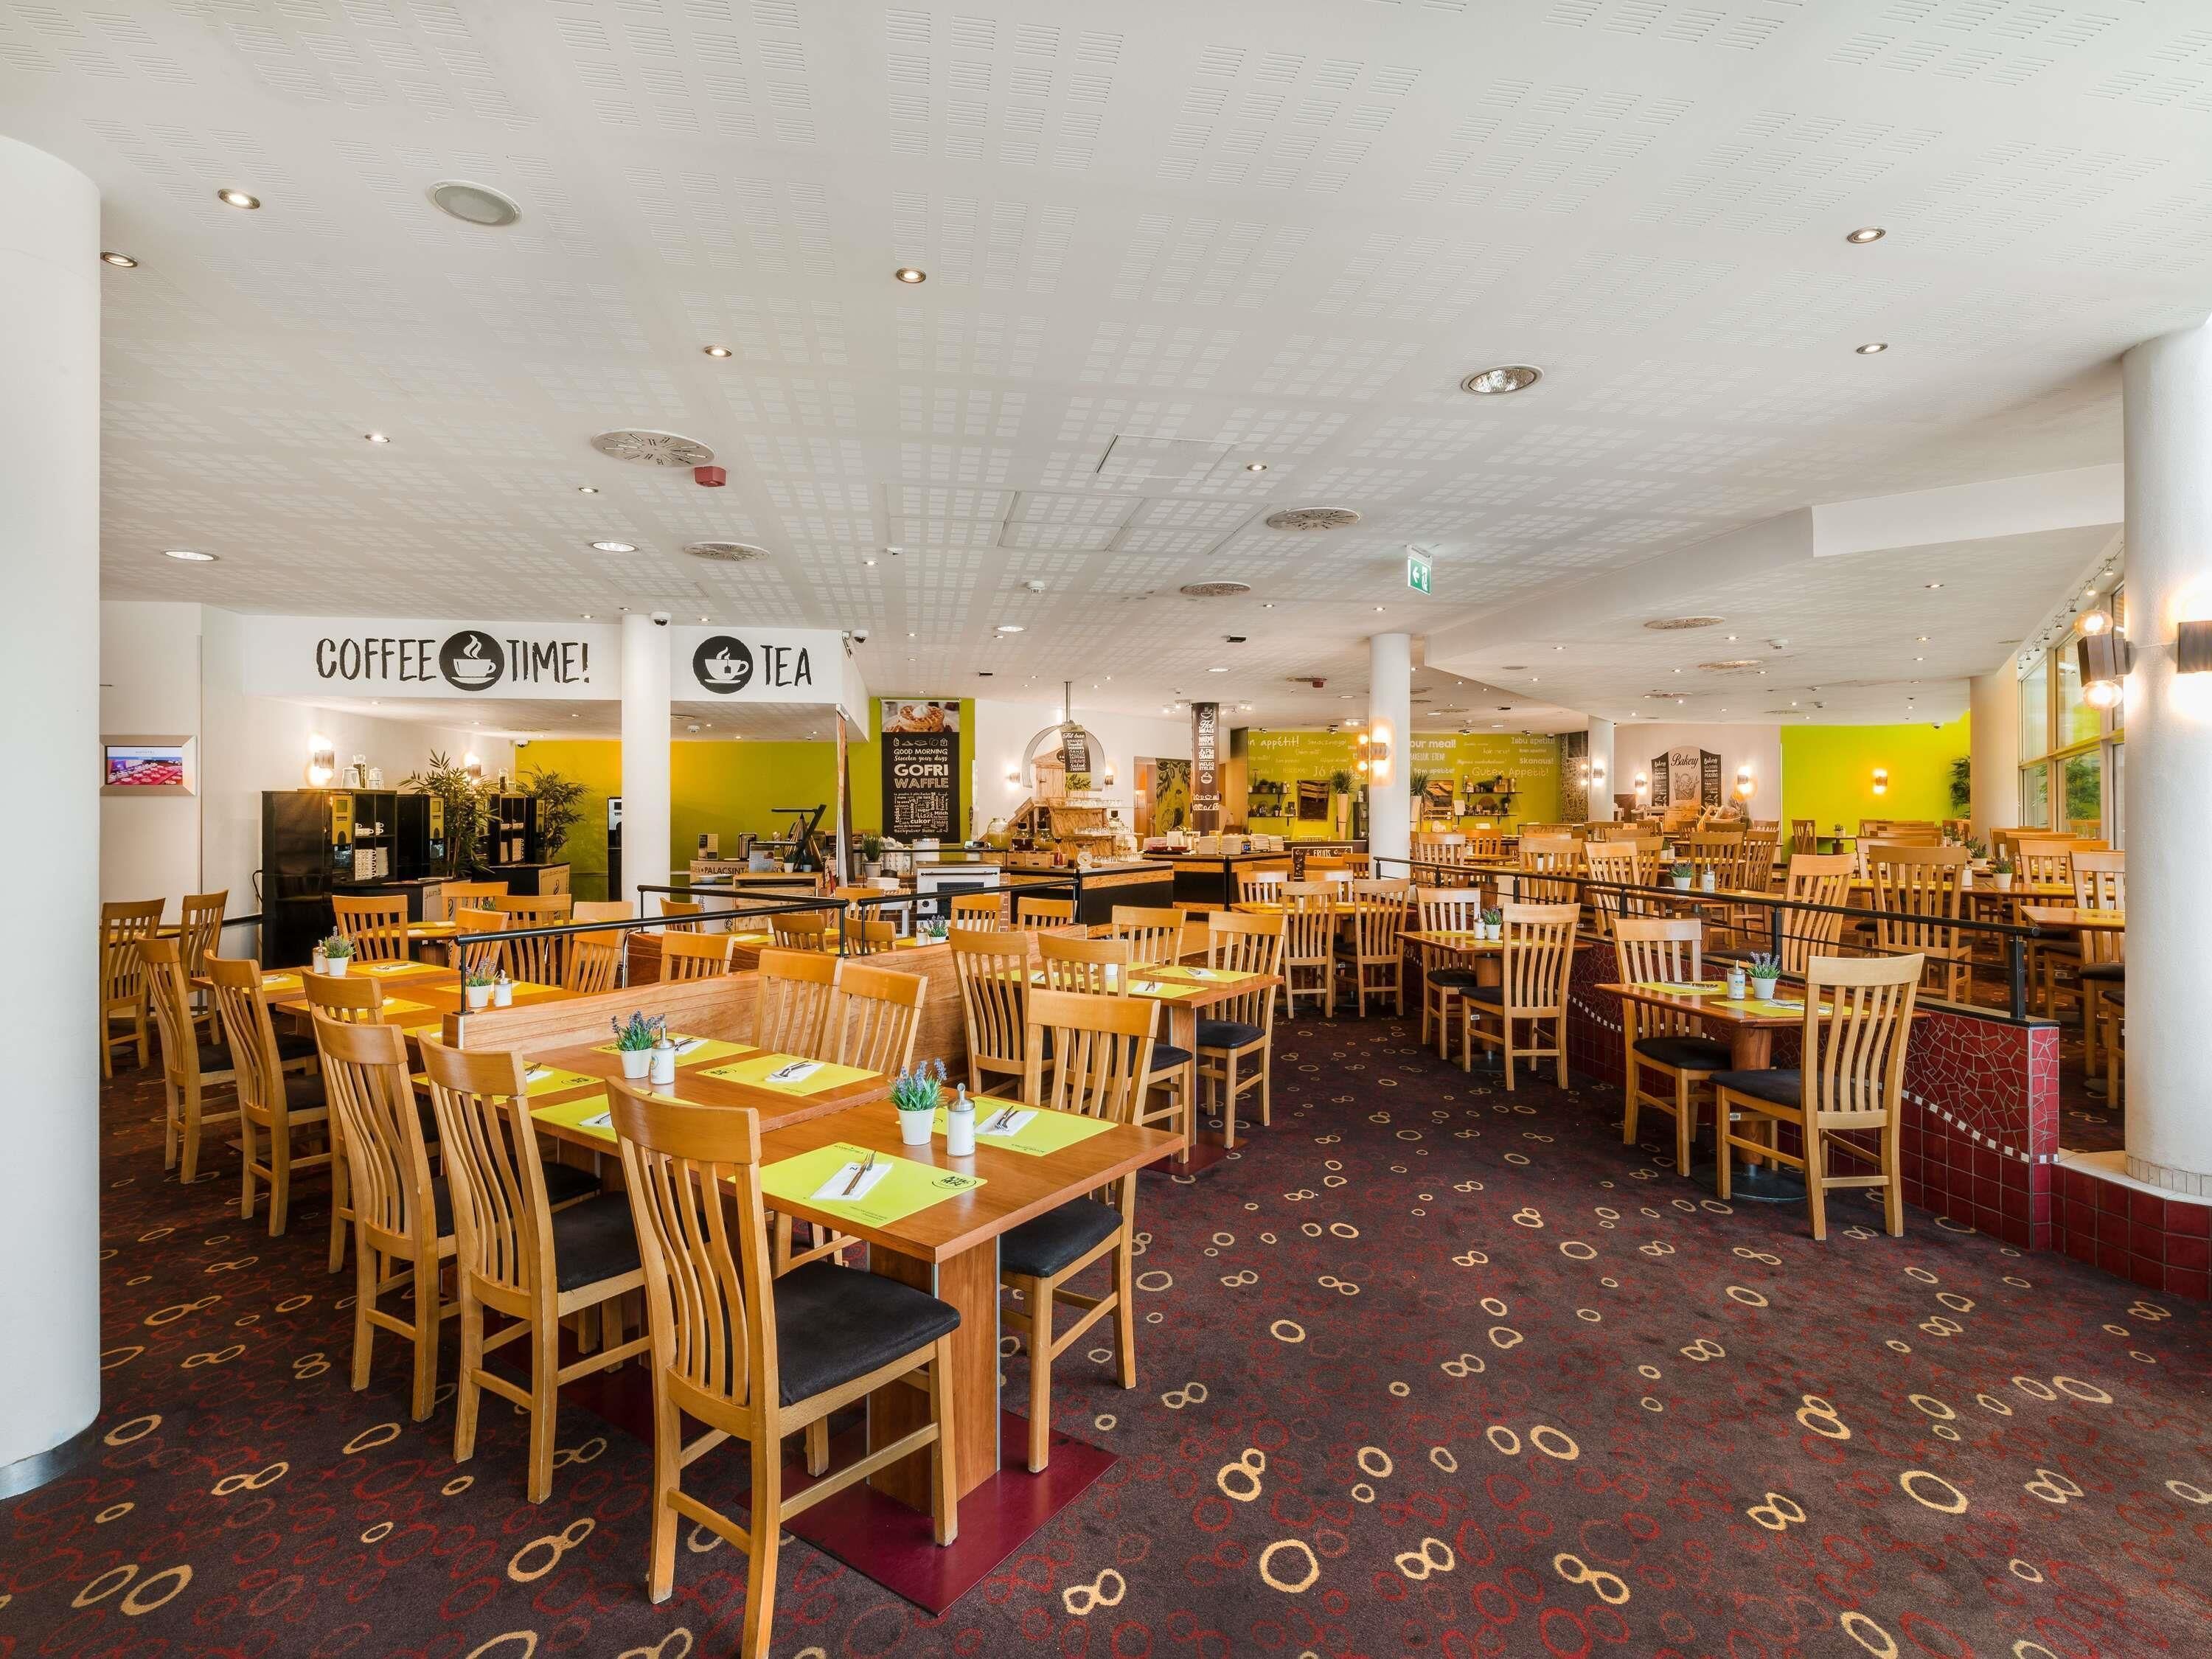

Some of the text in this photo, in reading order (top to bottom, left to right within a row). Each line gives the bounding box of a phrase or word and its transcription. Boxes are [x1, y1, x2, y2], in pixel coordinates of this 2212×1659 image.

[316, 637, 590, 684] COFFEE TIME!
[759, 644, 812, 687] TEA
[1260, 735, 1299, 749] appétit!
[1410, 739, 1456, 748] our meal!
[1671, 753, 1699, 768] Bakery
[894, 763, 949, 776] GOFRI
[1472, 767, 1549, 778] Guten Appetit!
[894, 777, 949, 789] WAFFLE
[1313, 849, 1332, 858] FRUITS
